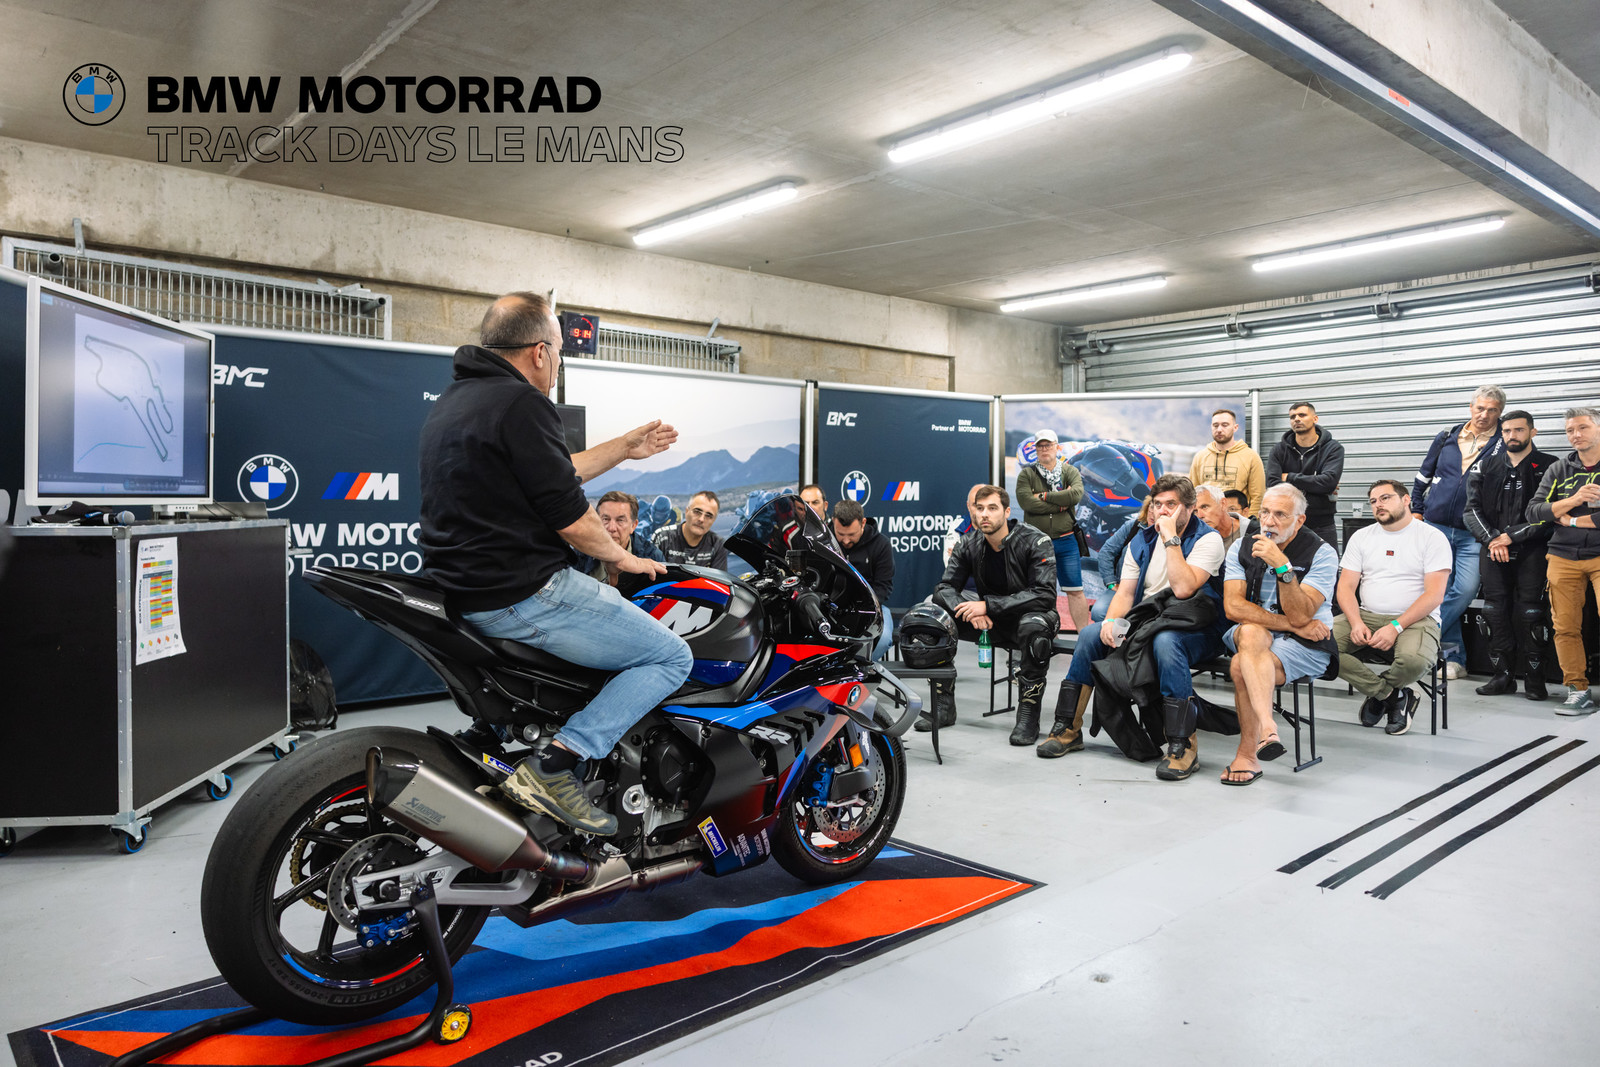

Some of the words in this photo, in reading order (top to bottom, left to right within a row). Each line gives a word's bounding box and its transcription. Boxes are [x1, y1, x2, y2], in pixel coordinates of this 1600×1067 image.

[573, 328, 592, 339] 9:14
[214, 364, 269, 388] BMC
[826, 411, 858, 427] BMC
[931, 424, 949, 432] Partner
[958, 425, 987, 434] MOTORRAD
[246, 456, 291, 474] BMW
[888, 515, 962, 533] MOTORR
[338, 522, 422, 546] MOTO
[748, 725, 793, 746] RR
[707, 830, 722, 853] MICHELIN
[333, 982, 407, 1004] MICHELIN
